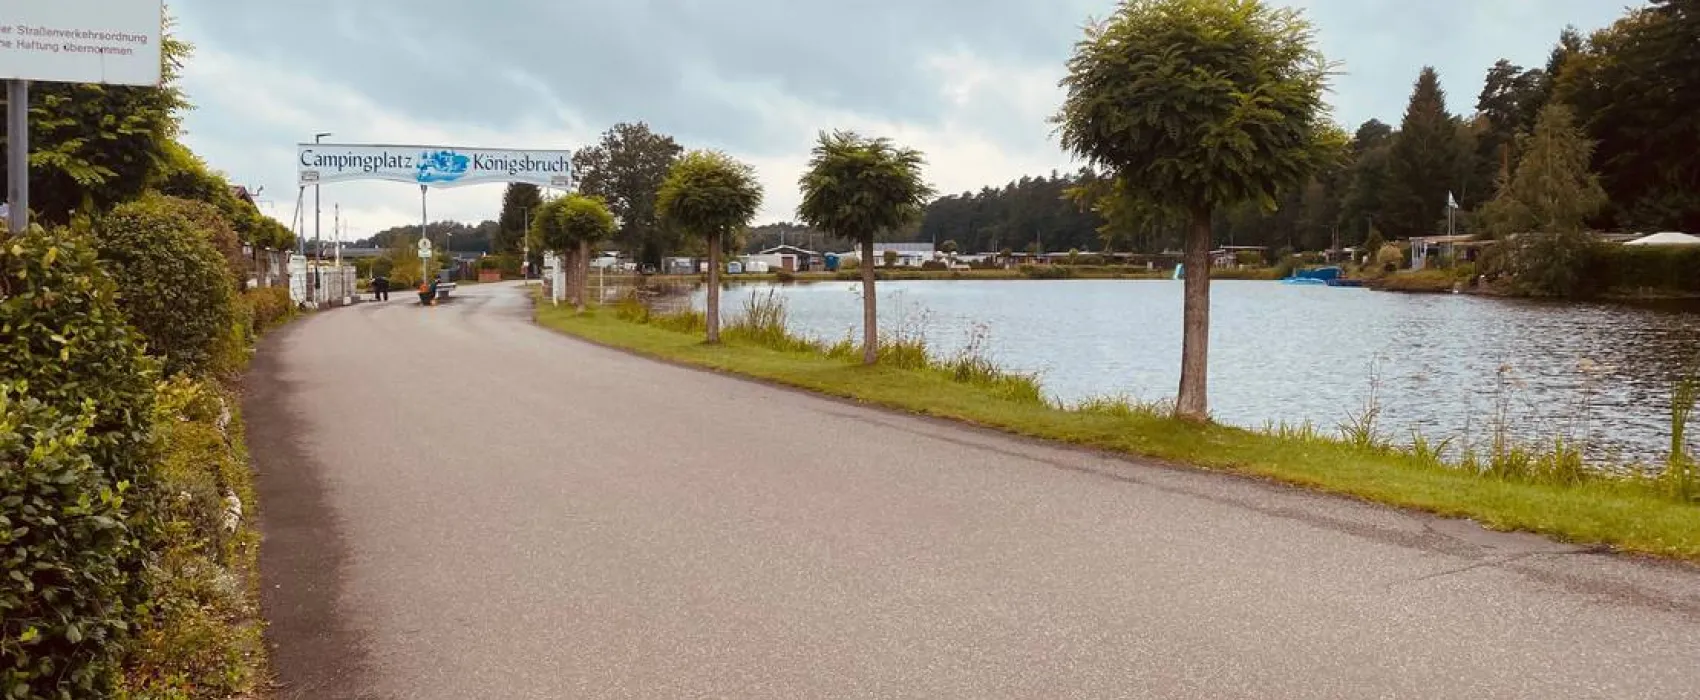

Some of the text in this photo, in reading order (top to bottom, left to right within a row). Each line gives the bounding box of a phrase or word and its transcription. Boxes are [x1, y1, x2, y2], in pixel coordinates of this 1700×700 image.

[17, 25, 148, 44] Straßenverkehrsordnung
[17, 39, 59, 53] Haftung
[63, 43, 133, 56] übernommen
[300, 149, 569, 175] Campingplatz Königsbruch
